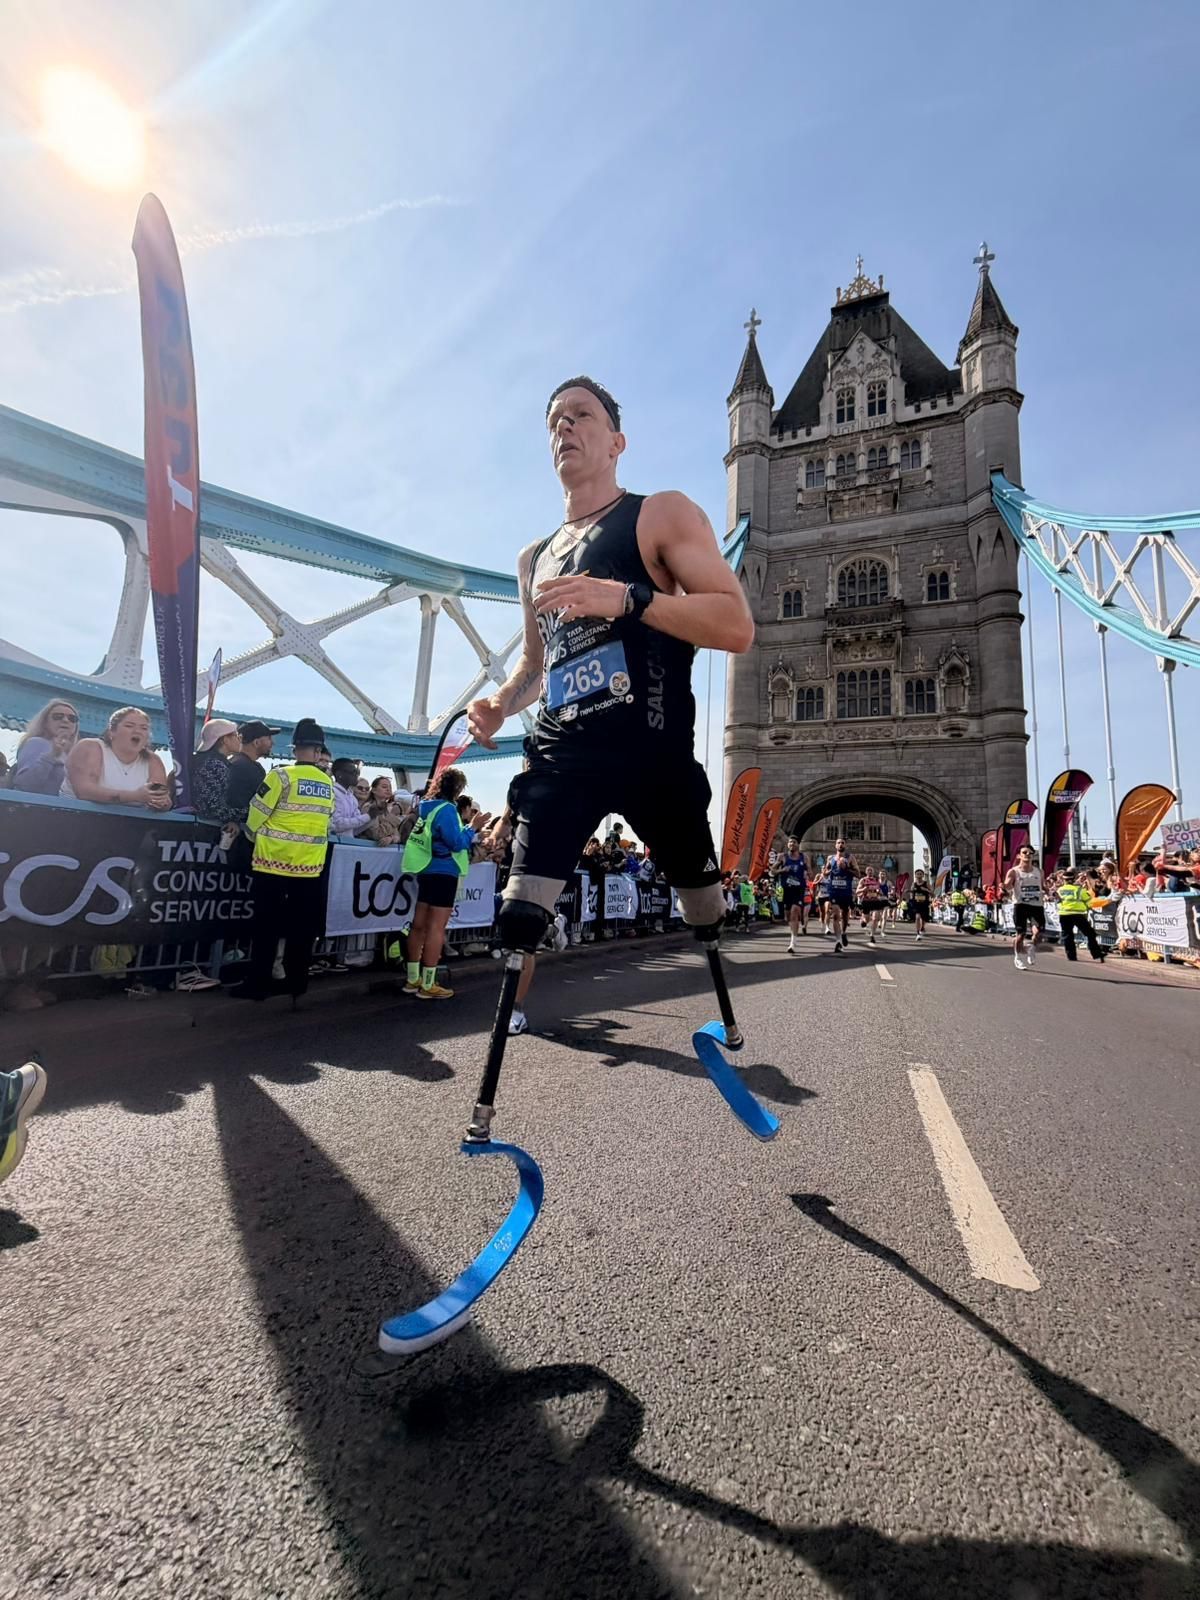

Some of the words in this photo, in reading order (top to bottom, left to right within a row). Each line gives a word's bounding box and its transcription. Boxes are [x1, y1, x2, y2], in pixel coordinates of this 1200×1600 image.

[566, 625, 584, 638] TATA
[568, 623, 611, 646] CONSULTANCY
[569, 636, 596, 654] SERVICES
[562, 659, 605, 699] 263
[580, 705, 594, 717] new
[594, 696, 625, 711] balance
[299, 784, 331, 798] POLICE
[728, 795, 749, 856] Leukaemia
[1166, 822, 1190, 833] YOU
[158, 840, 228, 864] TATA
[0, 852, 135, 926] cs
[352, 861, 414, 919] tcs
[149, 900, 255, 923] SERVICES
[1122, 906, 1144, 934] tcs
[1146, 906, 1159, 914] TATA
[1146, 916, 1179, 927] CONSULTANCY
[1146, 927, 1167, 937] SERVICES
